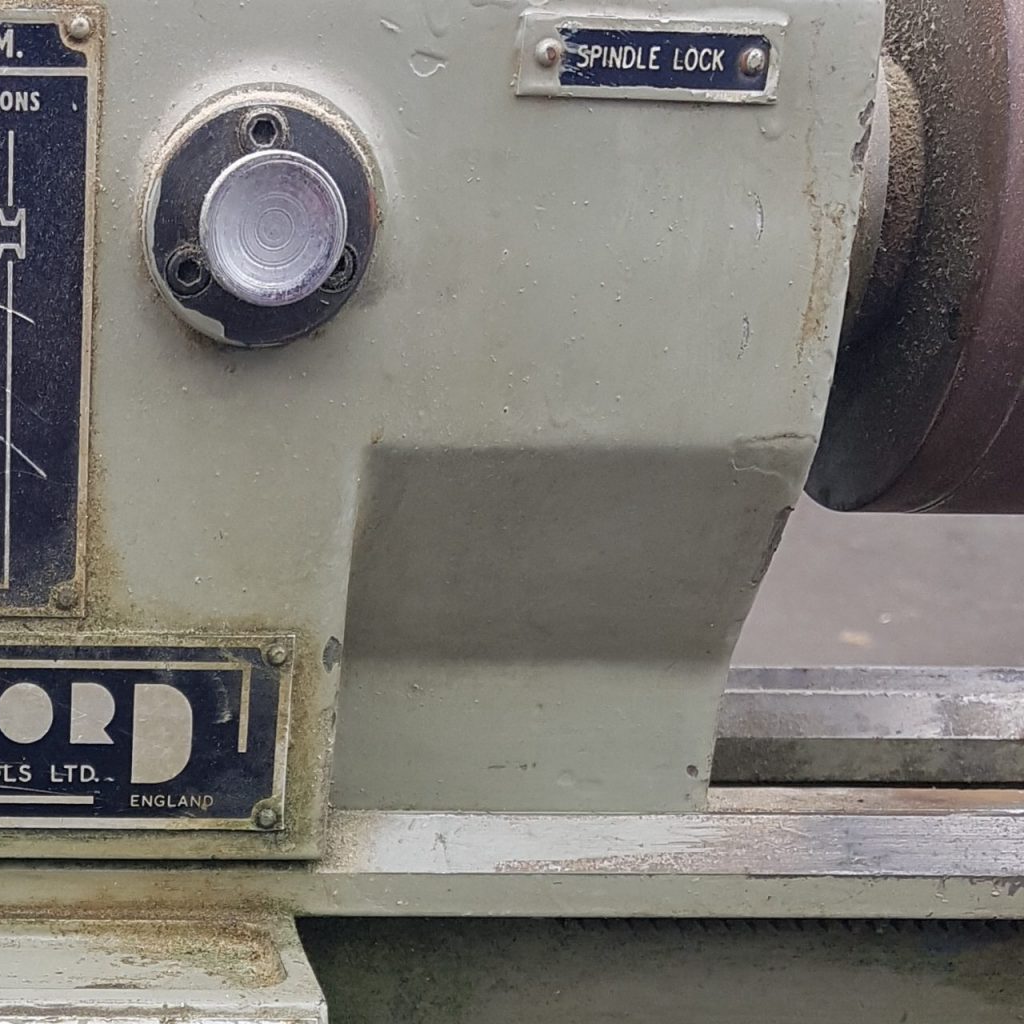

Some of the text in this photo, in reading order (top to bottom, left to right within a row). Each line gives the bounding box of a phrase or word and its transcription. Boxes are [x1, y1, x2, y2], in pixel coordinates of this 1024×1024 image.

[577, 45, 725, 72] SPINDLE LOCK
[51, 765, 100, 784] LTD.
[130, 794, 215, 809] ENGLAND
